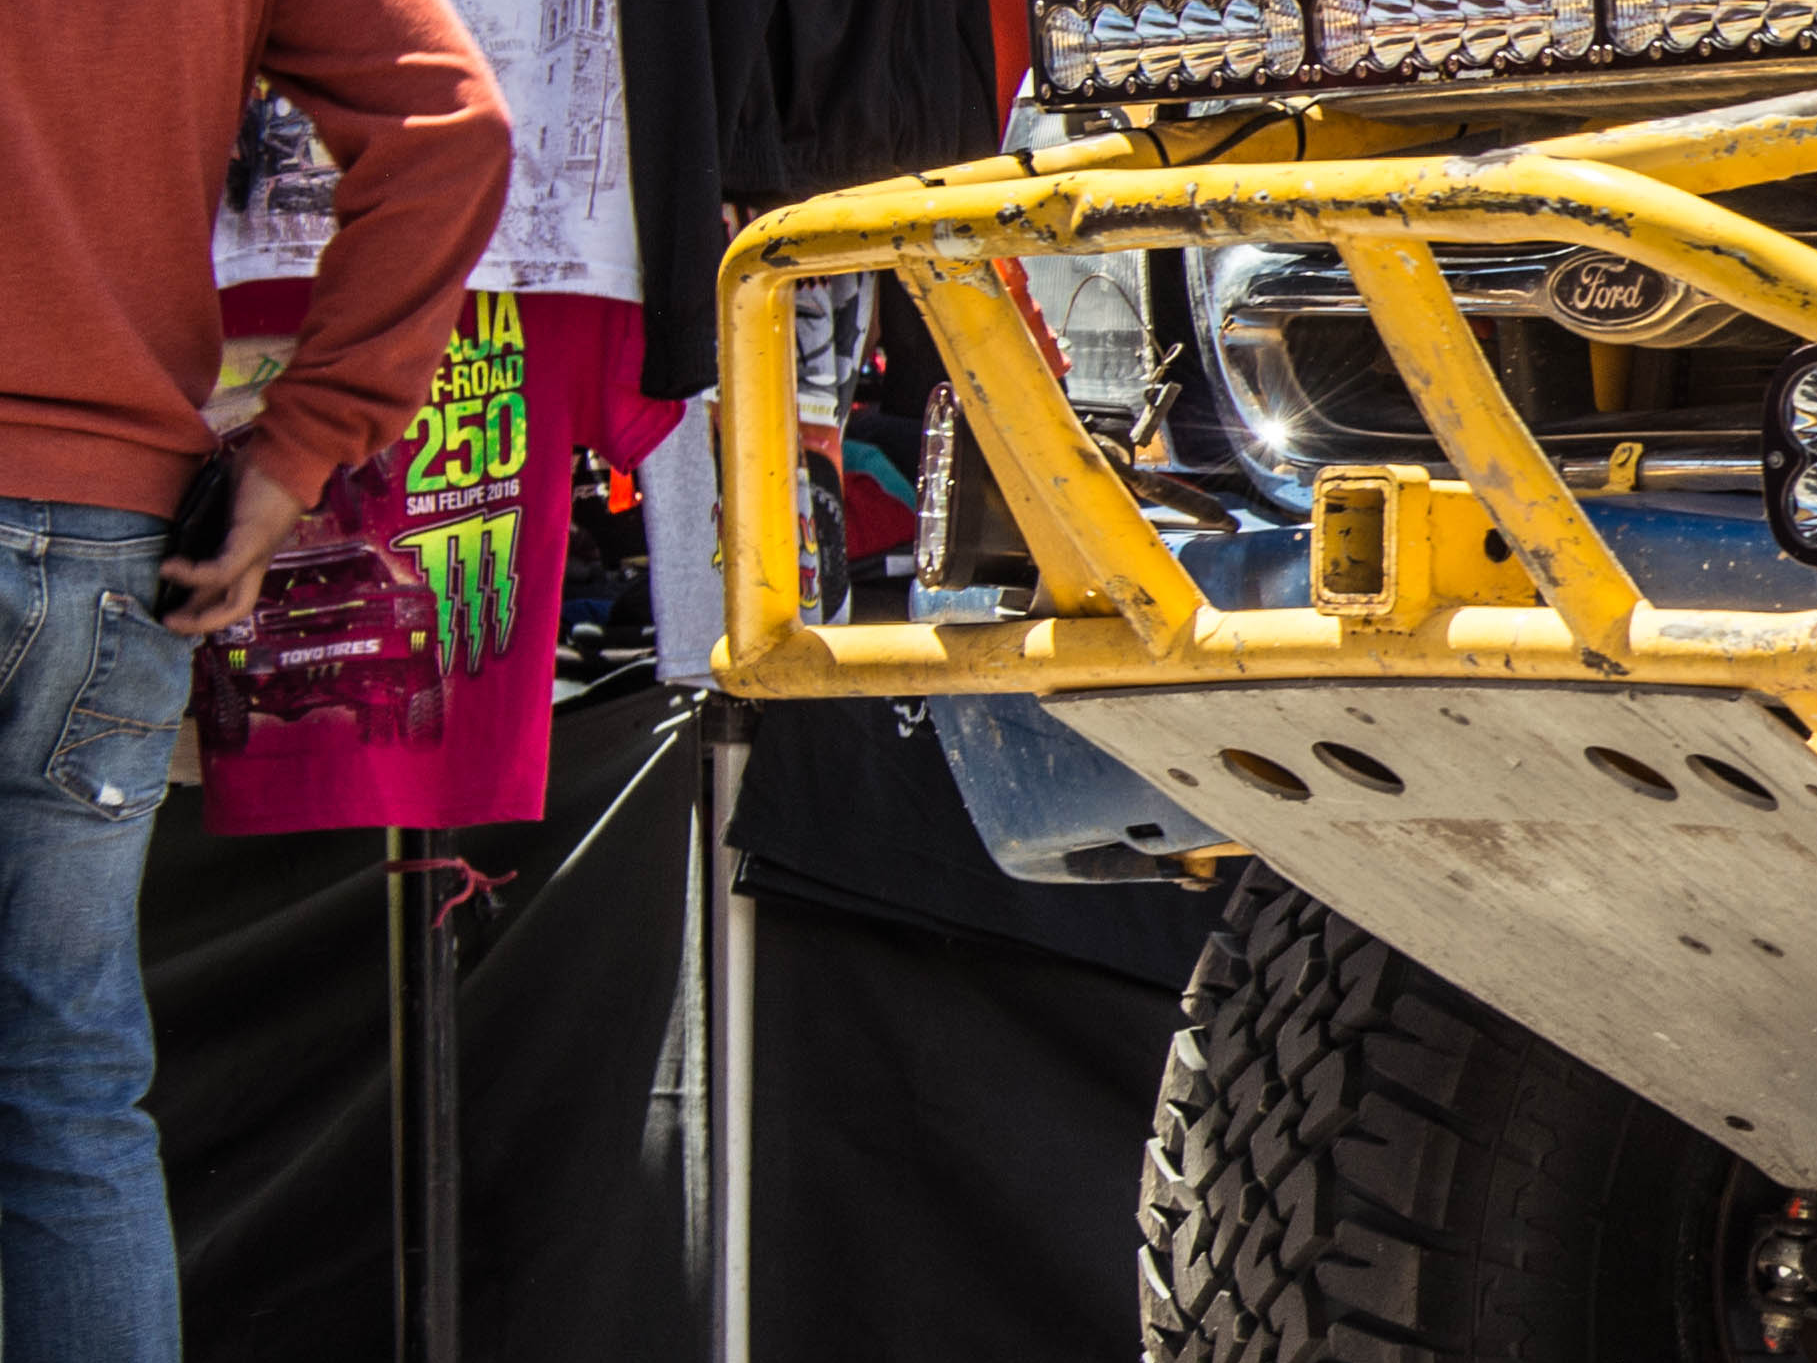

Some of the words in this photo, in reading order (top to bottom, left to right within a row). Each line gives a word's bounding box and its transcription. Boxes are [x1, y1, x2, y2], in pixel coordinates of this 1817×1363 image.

[1568, 258, 1645, 310] Ford
[402, 390, 528, 494] 250
[405, 494, 434, 517] SAN
[437, 485, 486, 512] FELIPE
[486, 478, 520, 506] 2016
[279, 645, 326, 666] TOYO
[325, 638, 382, 657] TIRES
